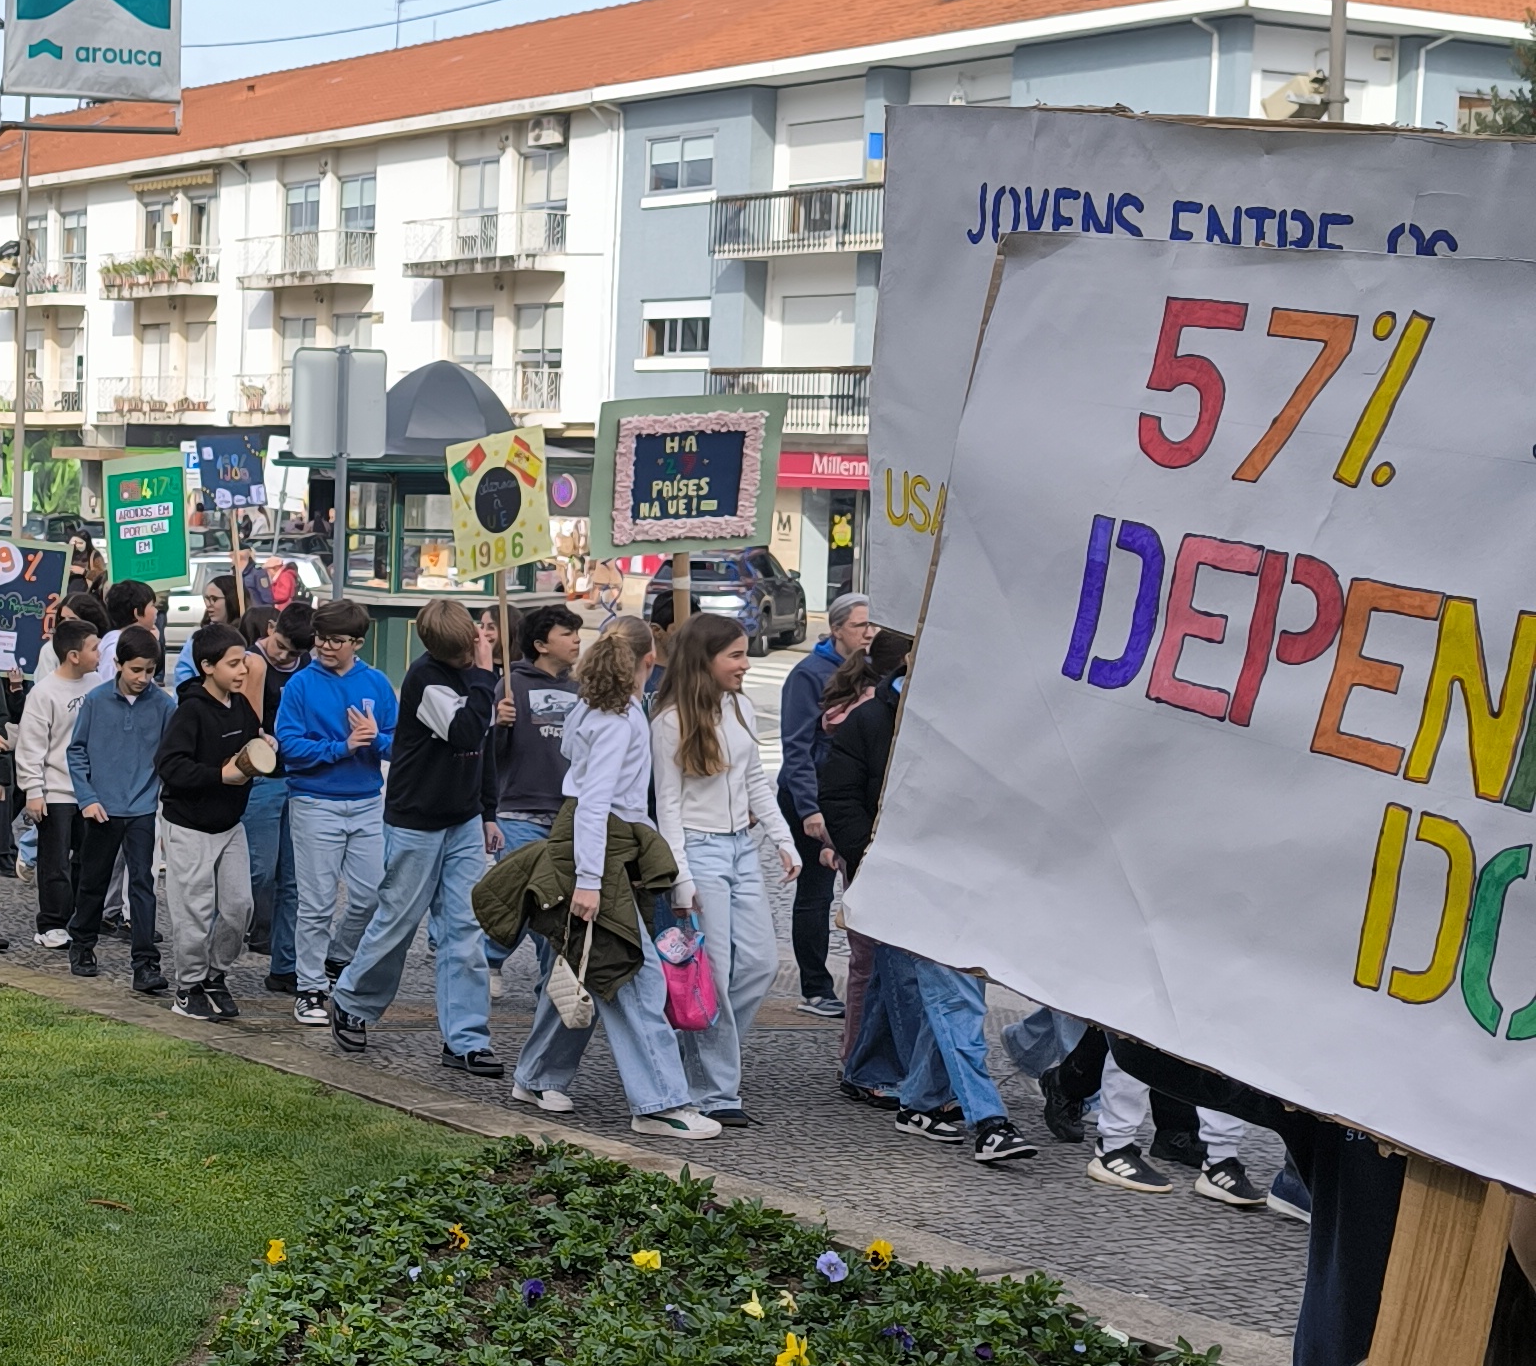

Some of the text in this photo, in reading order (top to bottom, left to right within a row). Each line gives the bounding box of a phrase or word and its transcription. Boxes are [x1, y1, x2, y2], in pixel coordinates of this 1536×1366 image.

[75, 45, 162, 67] arouca
[967, 182, 1145, 245] JOVENS
[1169, 200, 1354, 252] ENTRE
[1138, 297, 1435, 489] 57%
[665, 454, 697, 477] 27
[651, 473, 711, 499] PAÍSES
[157, 504, 170, 516] EM
[639, 500, 662, 518] NA
[123, 521, 167, 538] PORTUGAL
[138, 540, 151, 553] EM
[470, 530, 524, 572] 1986
[1061, 513, 1536, 813] DEPEN
